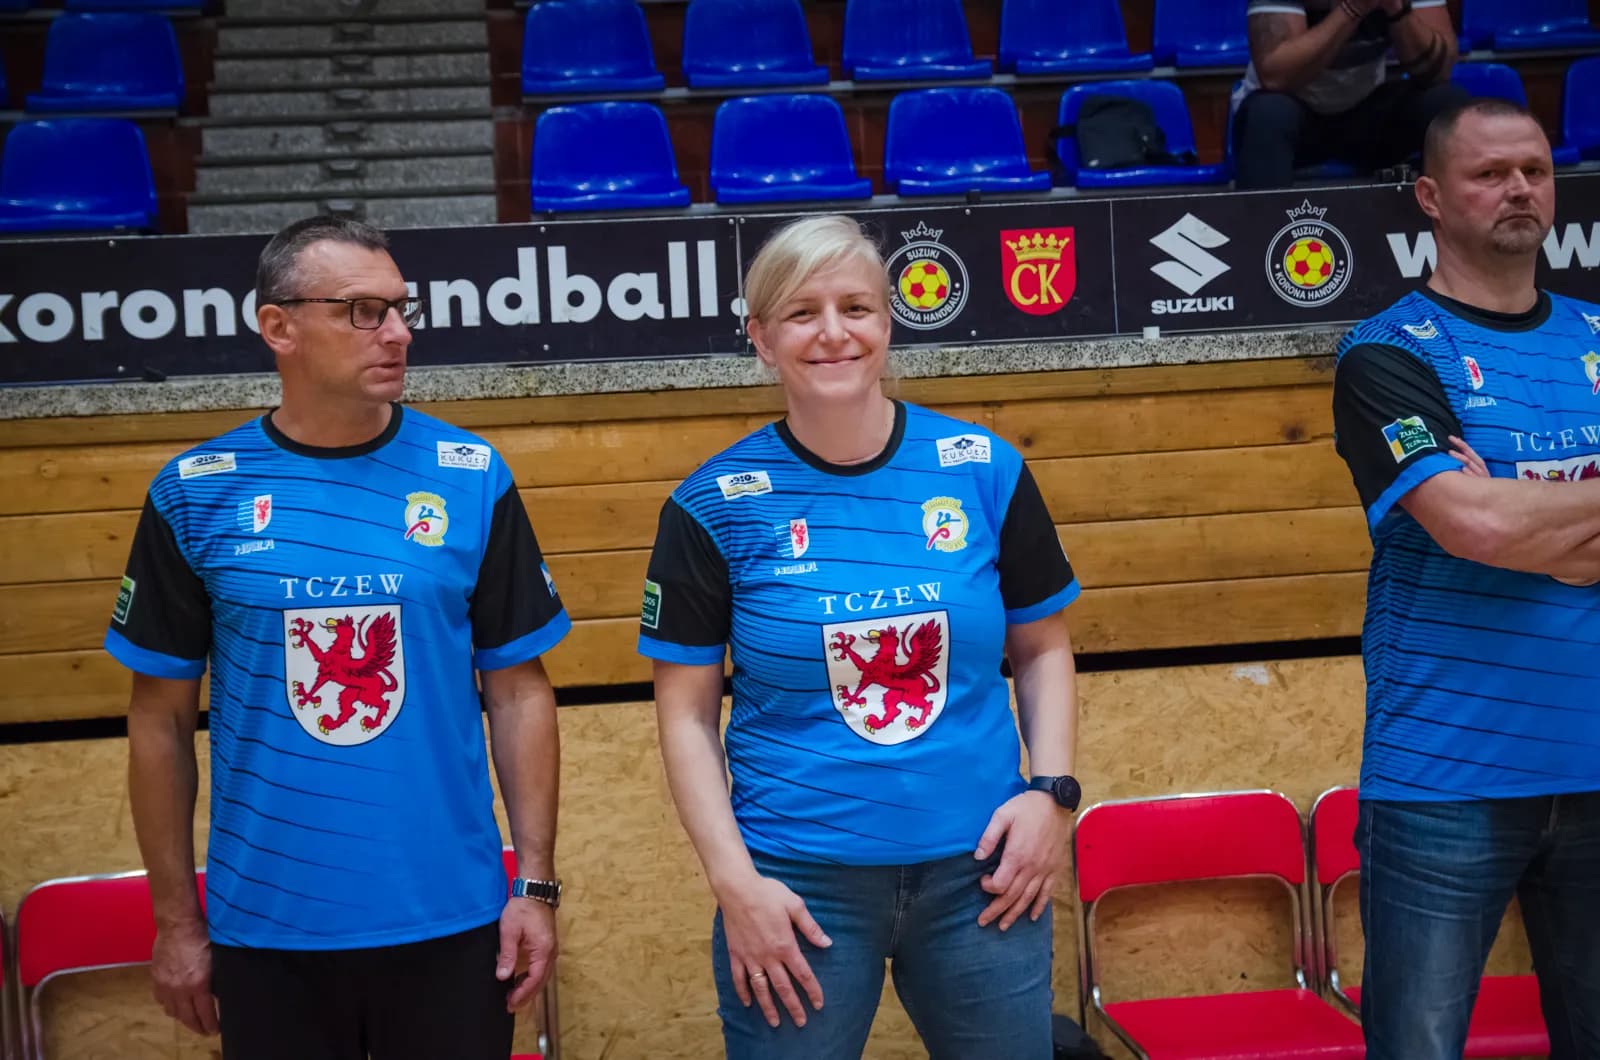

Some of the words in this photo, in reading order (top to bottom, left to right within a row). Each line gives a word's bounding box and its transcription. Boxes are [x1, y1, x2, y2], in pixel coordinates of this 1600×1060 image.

[1291, 226, 1324, 239] SUZUKI
[906, 248, 941, 262] SUZUKI
[1010, 262, 1063, 306] CK
[1275, 270, 1307, 300] KORONA
[1307, 267, 1345, 300] HANDBALL
[890, 292, 922, 323] KORONA
[923, 289, 962, 323] HANDBALL
[1151, 296, 1234, 315] SUZUKI
[280, 573, 404, 599] TCZEW
[818, 582, 943, 615] TCZEW
